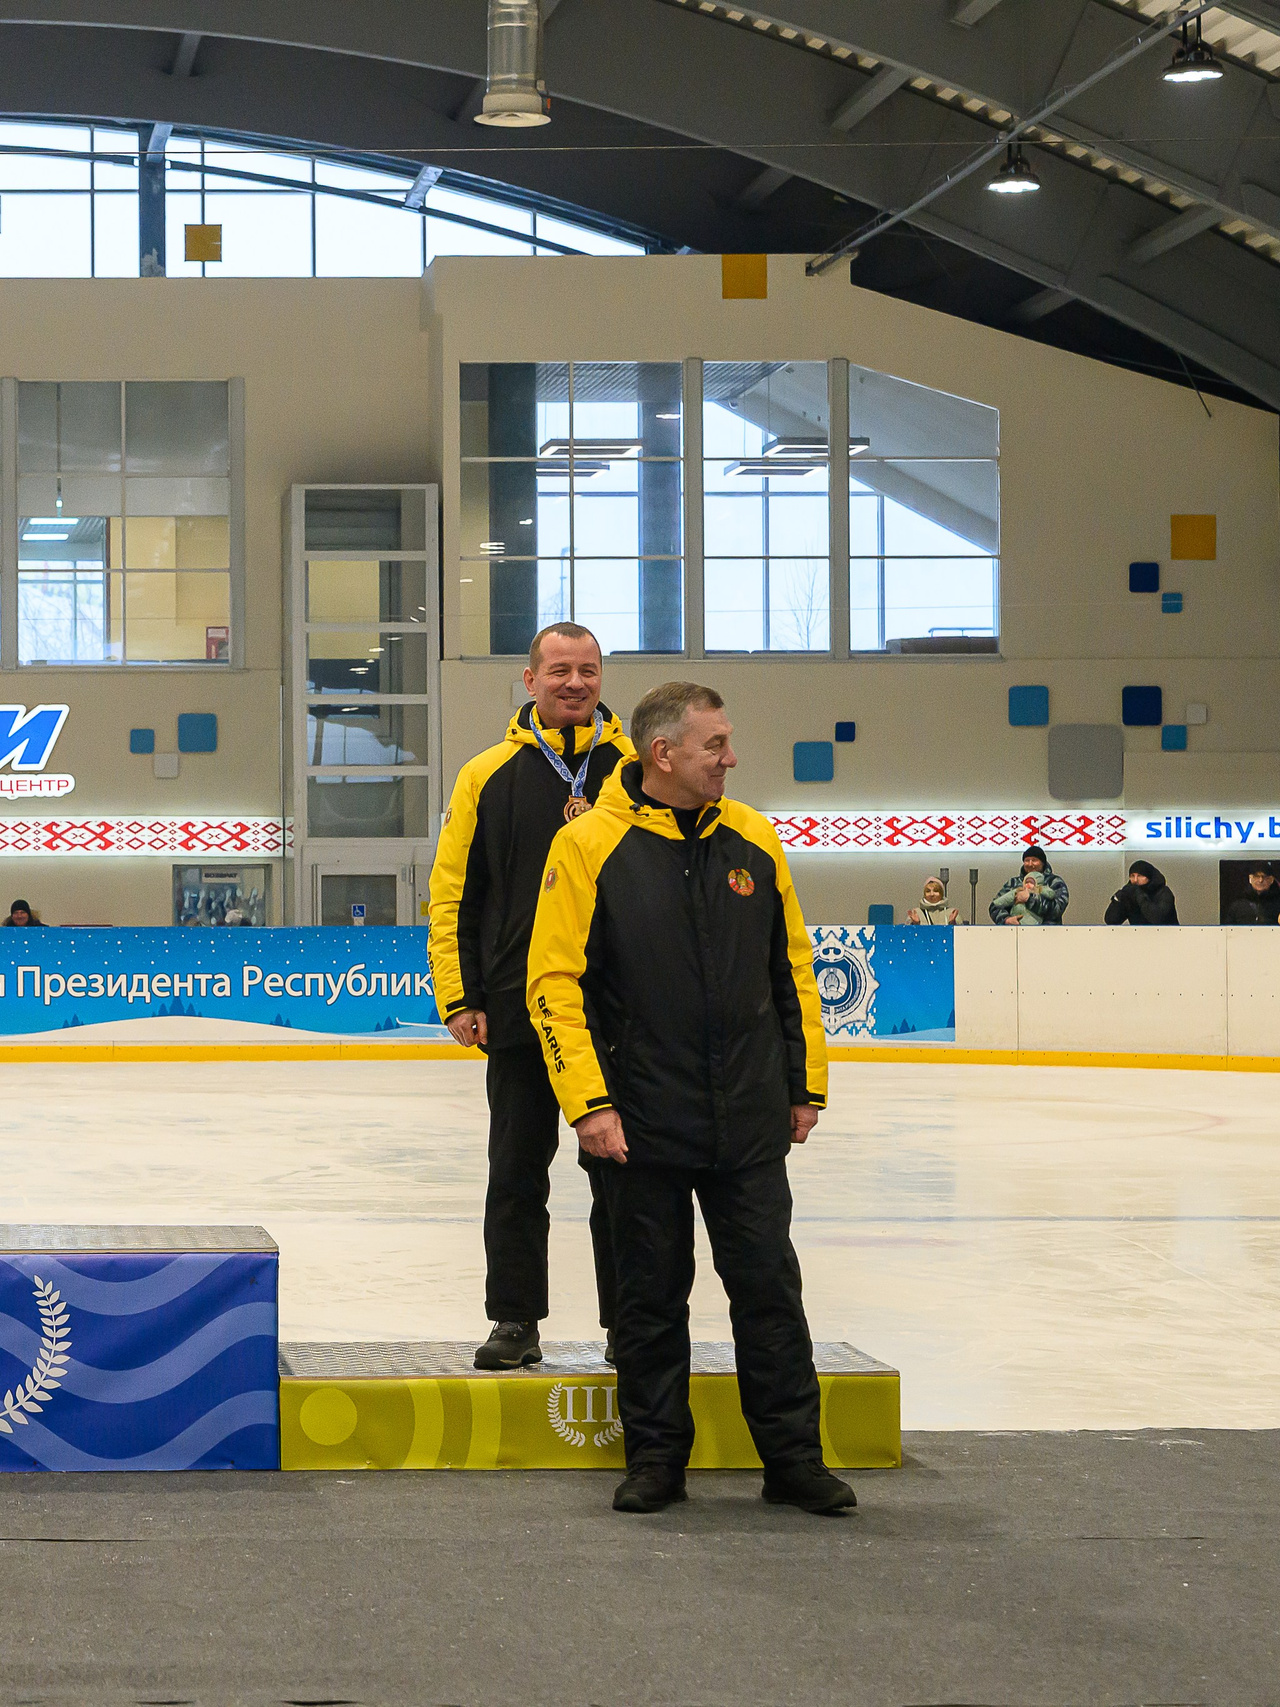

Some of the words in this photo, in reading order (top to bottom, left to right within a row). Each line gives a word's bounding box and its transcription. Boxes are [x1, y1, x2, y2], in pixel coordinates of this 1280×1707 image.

[0, 779, 69, 796] ЦЕНТР
[17, 965, 232, 1006] Президента
[242, 963, 434, 1005] Республик
[537, 995, 566, 1074] BELARUS
[562, 1386, 617, 1423] III
